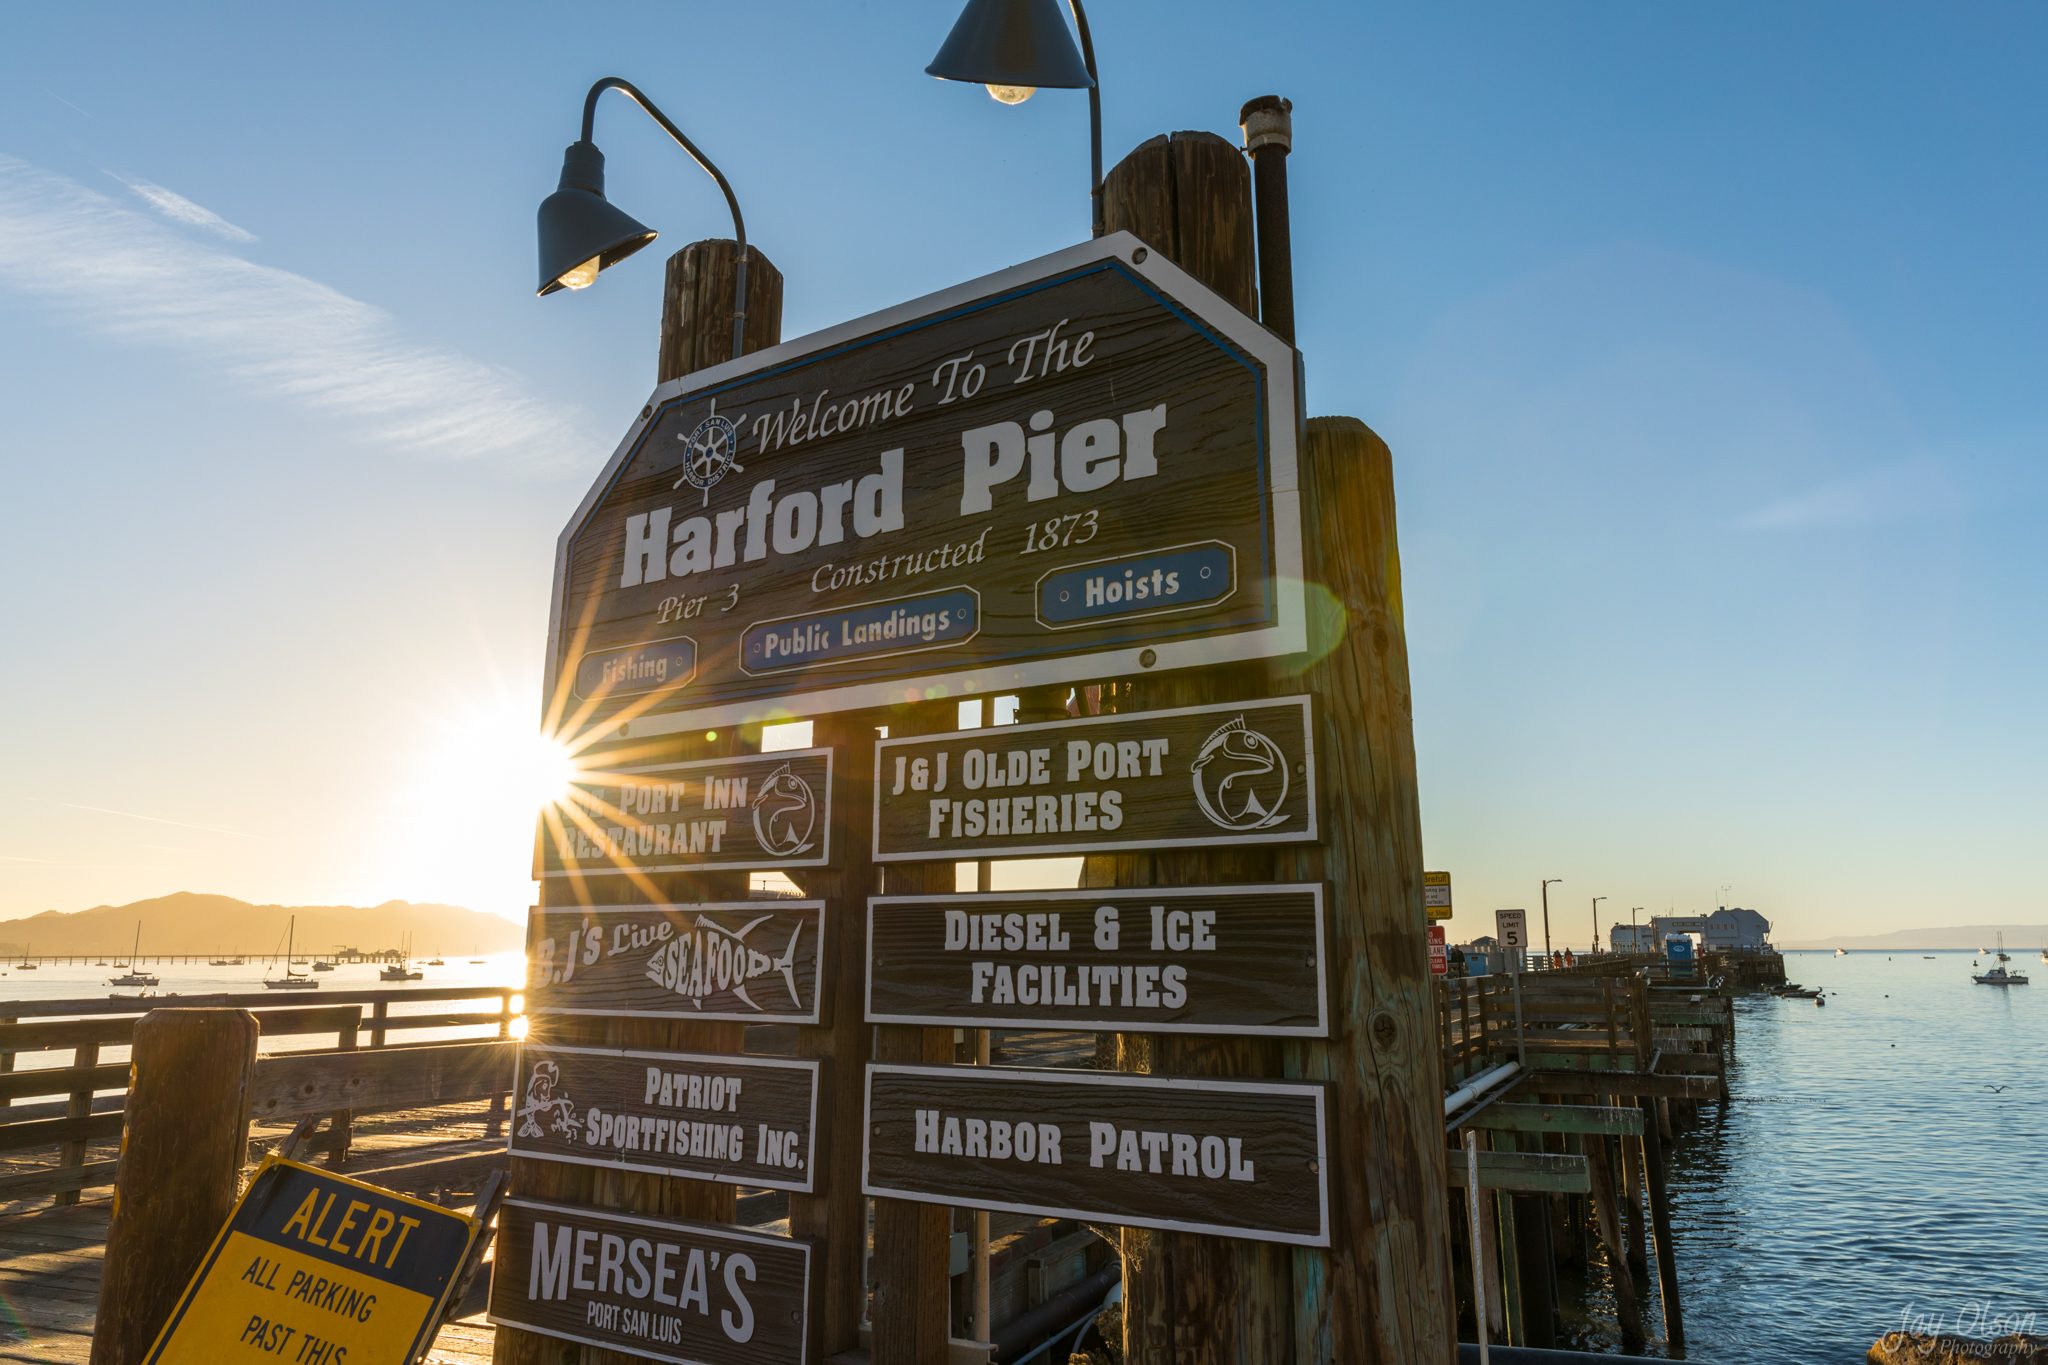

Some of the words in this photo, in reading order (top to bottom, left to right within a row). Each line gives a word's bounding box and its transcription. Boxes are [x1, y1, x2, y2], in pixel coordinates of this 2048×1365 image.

[753, 383, 914, 454] Welcome
[932, 350, 986, 405] To
[1008, 318, 1095, 384] The
[705, 418, 720, 428] SAN
[721, 422, 733, 437] LUIS
[620, 448, 905, 588] Harford
[960, 403, 1167, 516] Pier
[812, 527, 993, 593] Constructed
[1020, 510, 1099, 555] 1873
[657, 596, 708, 625] Pier
[720, 584, 739, 612] 3
[1085, 569, 1179, 607] Hoists
[764, 623, 829, 658] Public
[841, 608, 950, 646] Landings
[602, 654, 667, 683] Fishing
[962, 748, 1050, 790] OLDE
[1067, 738, 1169, 783] PORT
[619, 782, 685, 816] PORT
[703, 775, 749, 810] INN
[929, 790, 1124, 839] FISHERIES
[560, 820, 727, 860] RESTAURANT
[607, 920, 674, 957] Live
[945, 910, 1070, 952] DIESEL
[1094, 906, 1120, 951] &
[1150, 905, 1216, 951] ICE
[1507, 931, 1518, 945] 5
[664, 930, 772, 997] SEAFOOD
[971, 961, 1187, 1009] FACILITIES
[644, 1067, 742, 1112] PATRIOT
[586, 1107, 744, 1162] SPORTFISHING
[756, 1124, 805, 1170] INC.
[914, 1109, 1063, 1165] HARBOR
[1089, 1121, 1255, 1182] PATROL
[280, 1187, 421, 1270] ALERT
[241, 1256, 281, 1292] ALL
[285, 1270, 377, 1323] PARKING
[528, 1221, 757, 1344] MERSEA'S
[240, 1315, 295, 1357] PAST
[300, 1333, 348, 1365] THIS
[587, 1300, 621, 1329] PORT
[623, 1308, 649, 1339] SAN
[652, 1317, 683, 1345] LUIS
